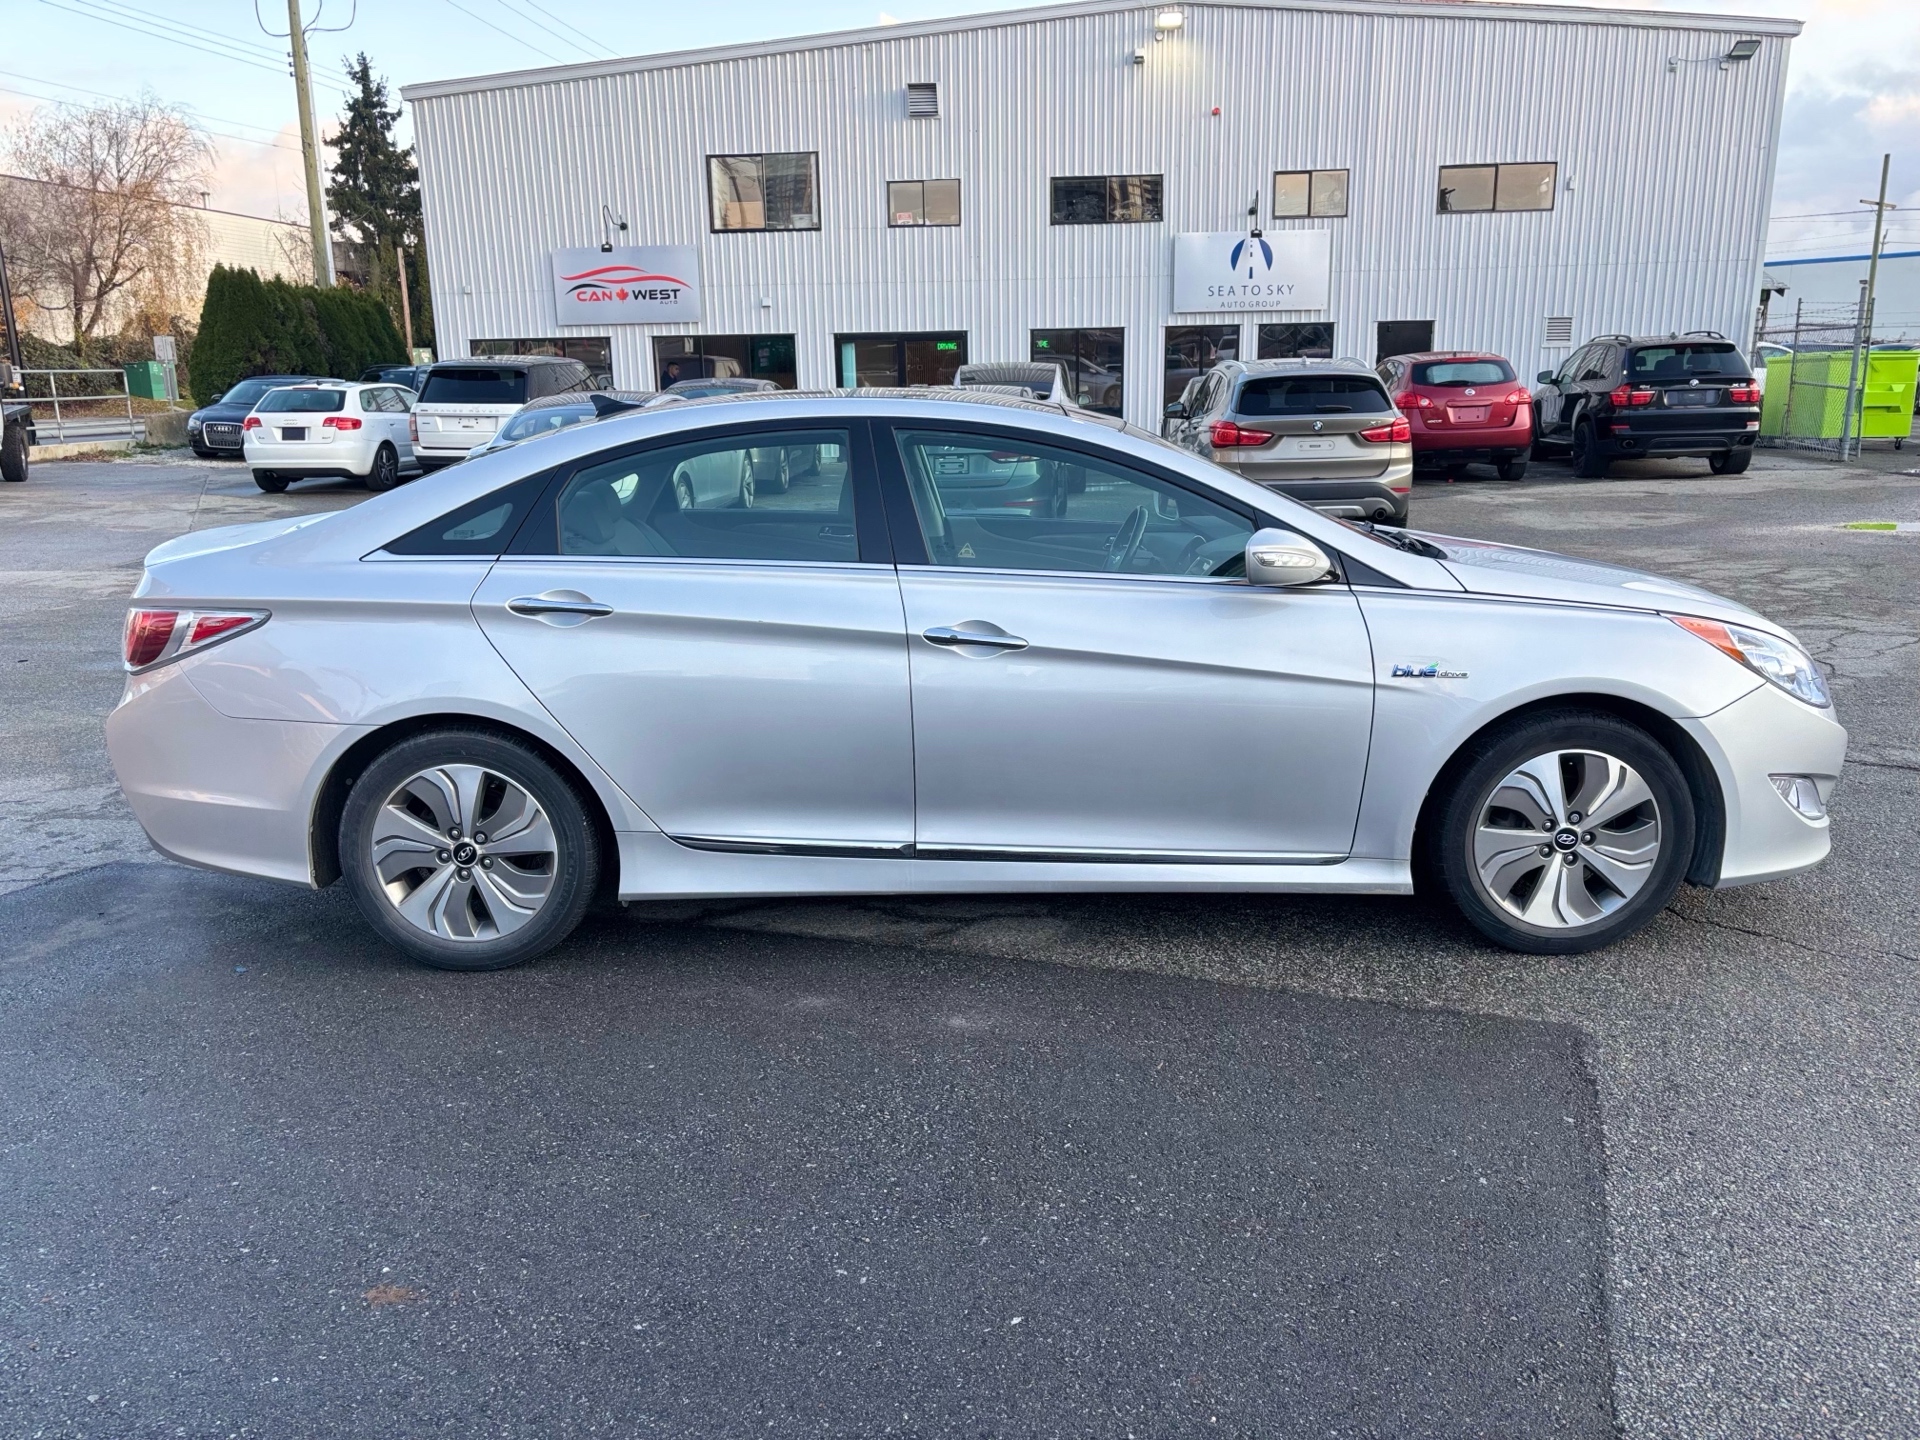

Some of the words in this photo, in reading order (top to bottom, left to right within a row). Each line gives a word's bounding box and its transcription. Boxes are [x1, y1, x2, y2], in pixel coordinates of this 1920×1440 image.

[576, 290, 613, 302] CAN
[632, 288, 681, 301] WEST
[1208, 285, 1236, 297] SEA
[1241, 284, 1261, 296] TO
[1267, 284, 1295, 296] SKY
[1220, 301, 1246, 309] AUTO
[1249, 300, 1281, 308] GROUP
[1391, 663, 1437, 678] blue
